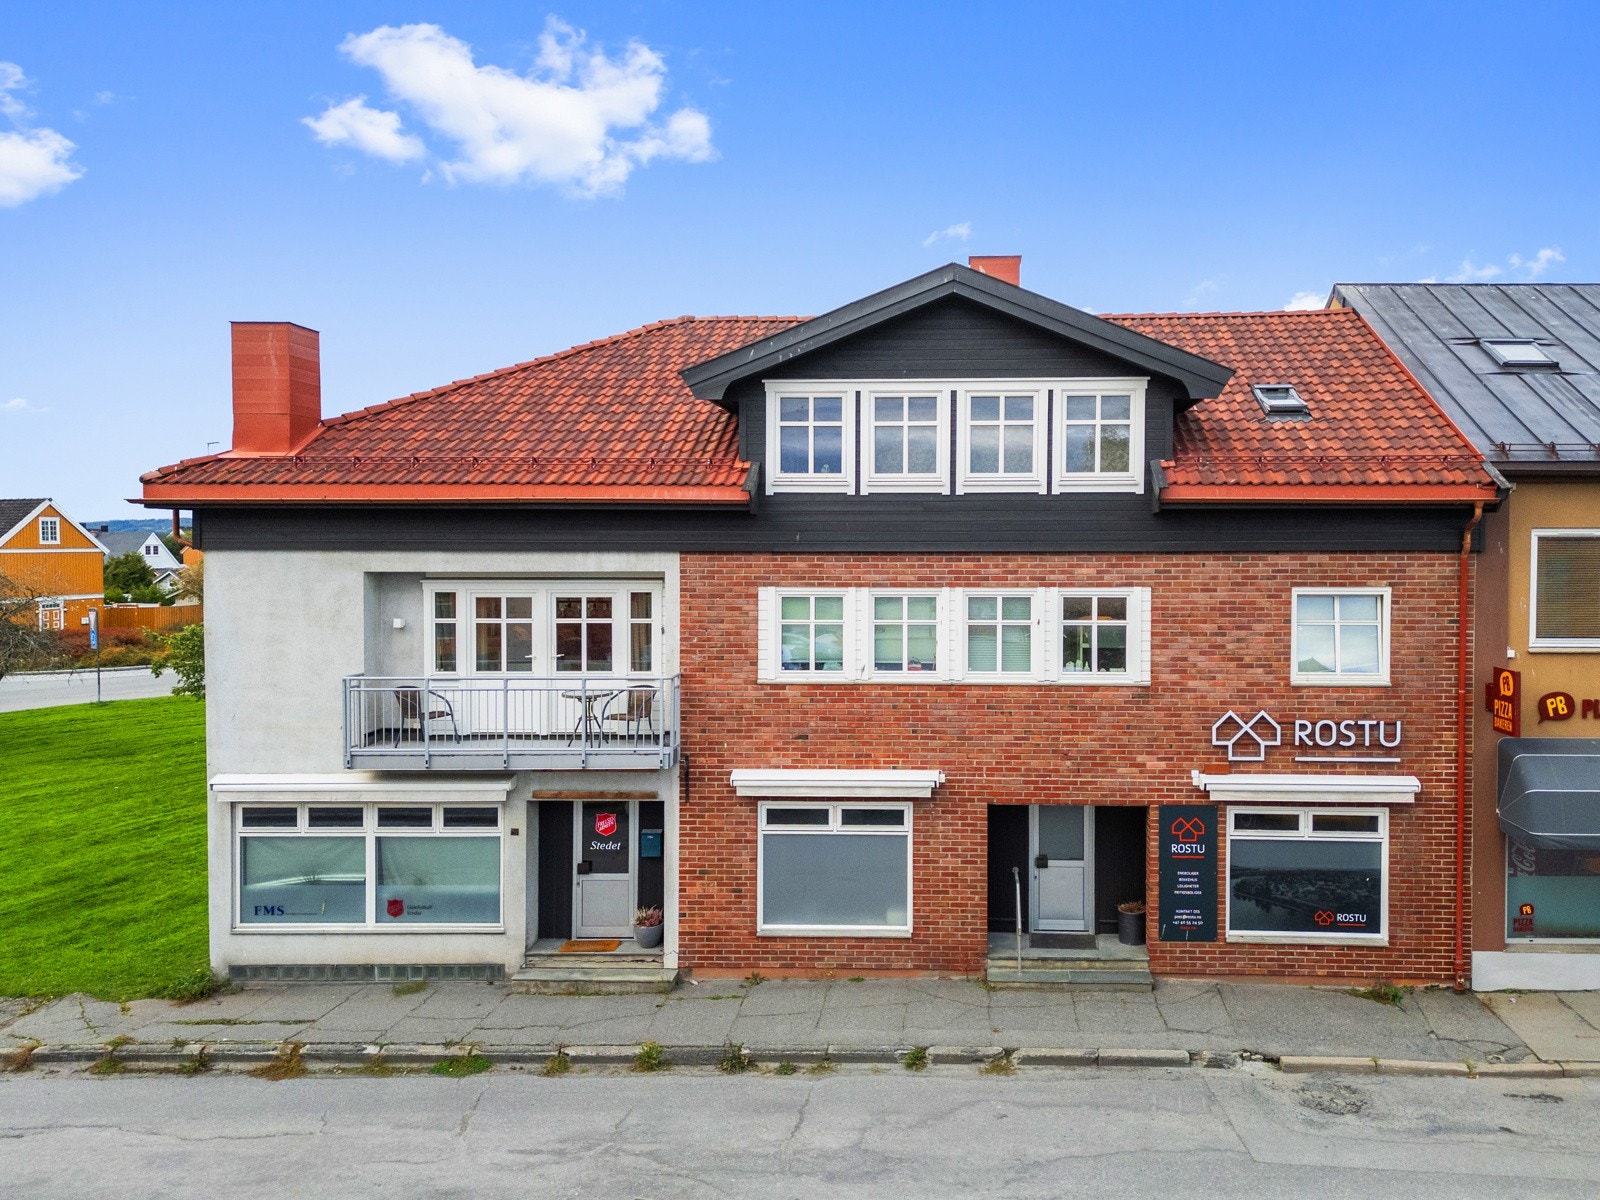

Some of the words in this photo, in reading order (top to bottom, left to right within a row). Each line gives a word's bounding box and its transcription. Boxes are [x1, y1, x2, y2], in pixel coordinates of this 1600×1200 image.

[1502, 675, 1511, 692] PB
[1494, 699, 1513, 719] PIZZA
[1546, 696, 1568, 717] PB
[1582, 699, 1600, 719] PI
[1294, 719, 1402, 747] ROSTU
[590, 840, 621, 850] Stedet
[1171, 844, 1205, 854] ROSTU
[253, 905, 285, 916] FMS
[1522, 905, 1532, 915] PB
[1336, 913, 1367, 923] ROSTU
[1513, 918, 1533, 926] PIZZA
